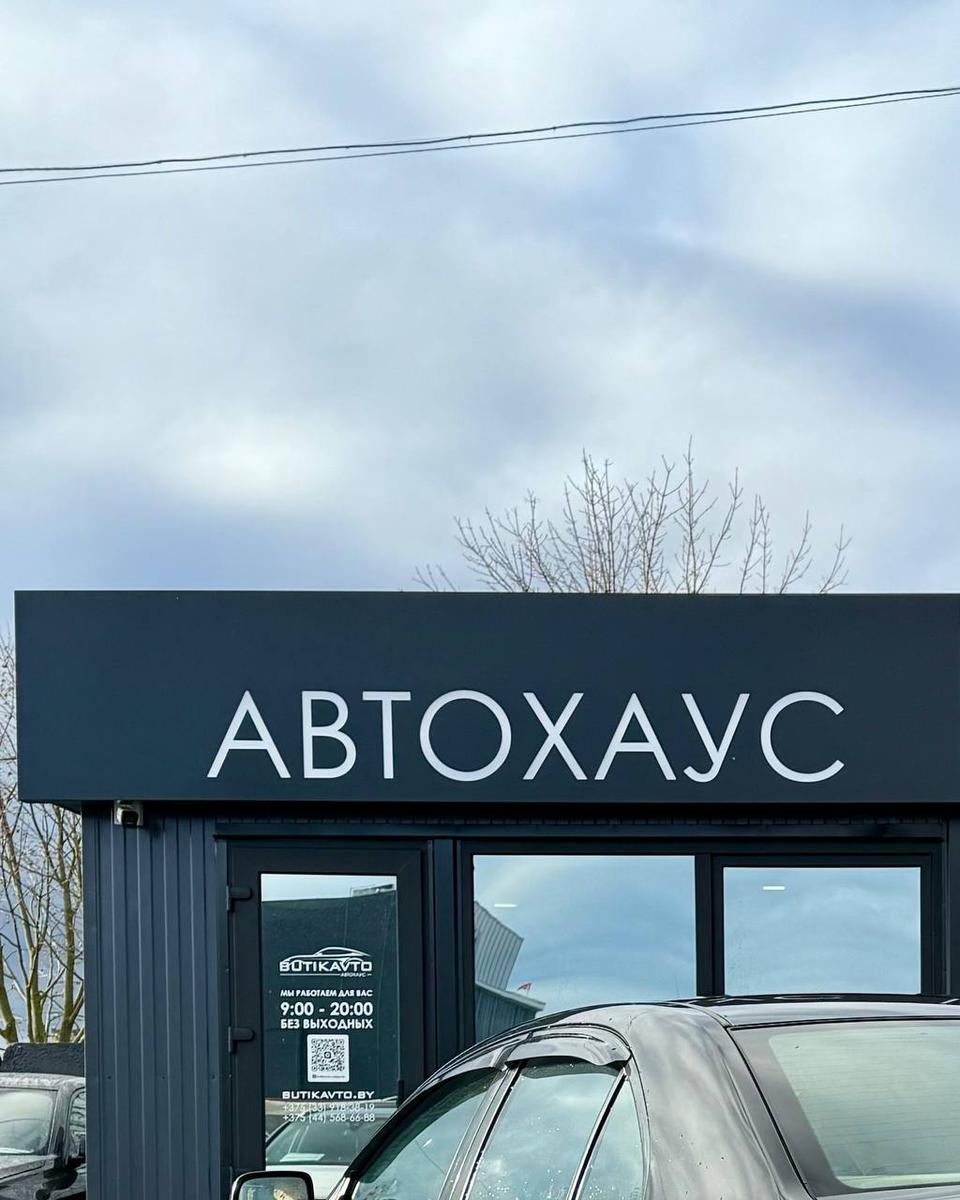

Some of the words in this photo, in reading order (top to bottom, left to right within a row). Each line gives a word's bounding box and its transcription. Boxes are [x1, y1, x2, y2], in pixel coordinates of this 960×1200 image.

[207, 689, 845, 783] АВТОХАУС
[279, 961, 373, 972] BUTIKAVTO
[280, 989, 295, 997] МЫ
[296, 989, 337, 997] РАБОТАЕМ
[338, 989, 355, 998] ДЛЯ
[356, 989, 374, 997] ВАС
[280, 1002, 314, 1016] 9:00
[330, 1002, 374, 1016] 20:00
[280, 1019, 300, 1029] БЕЗ
[303, 1019, 374, 1030] ВЫХОДНЫХ
[282, 1091, 375, 1099] BUTIKAVTO.BY
[283, 1103, 306, 1112] +375
[283, 1113, 306, 1122] +375
[309, 1112, 327, 1124] (44)
[329, 1112, 376, 1122] 568-66-88
